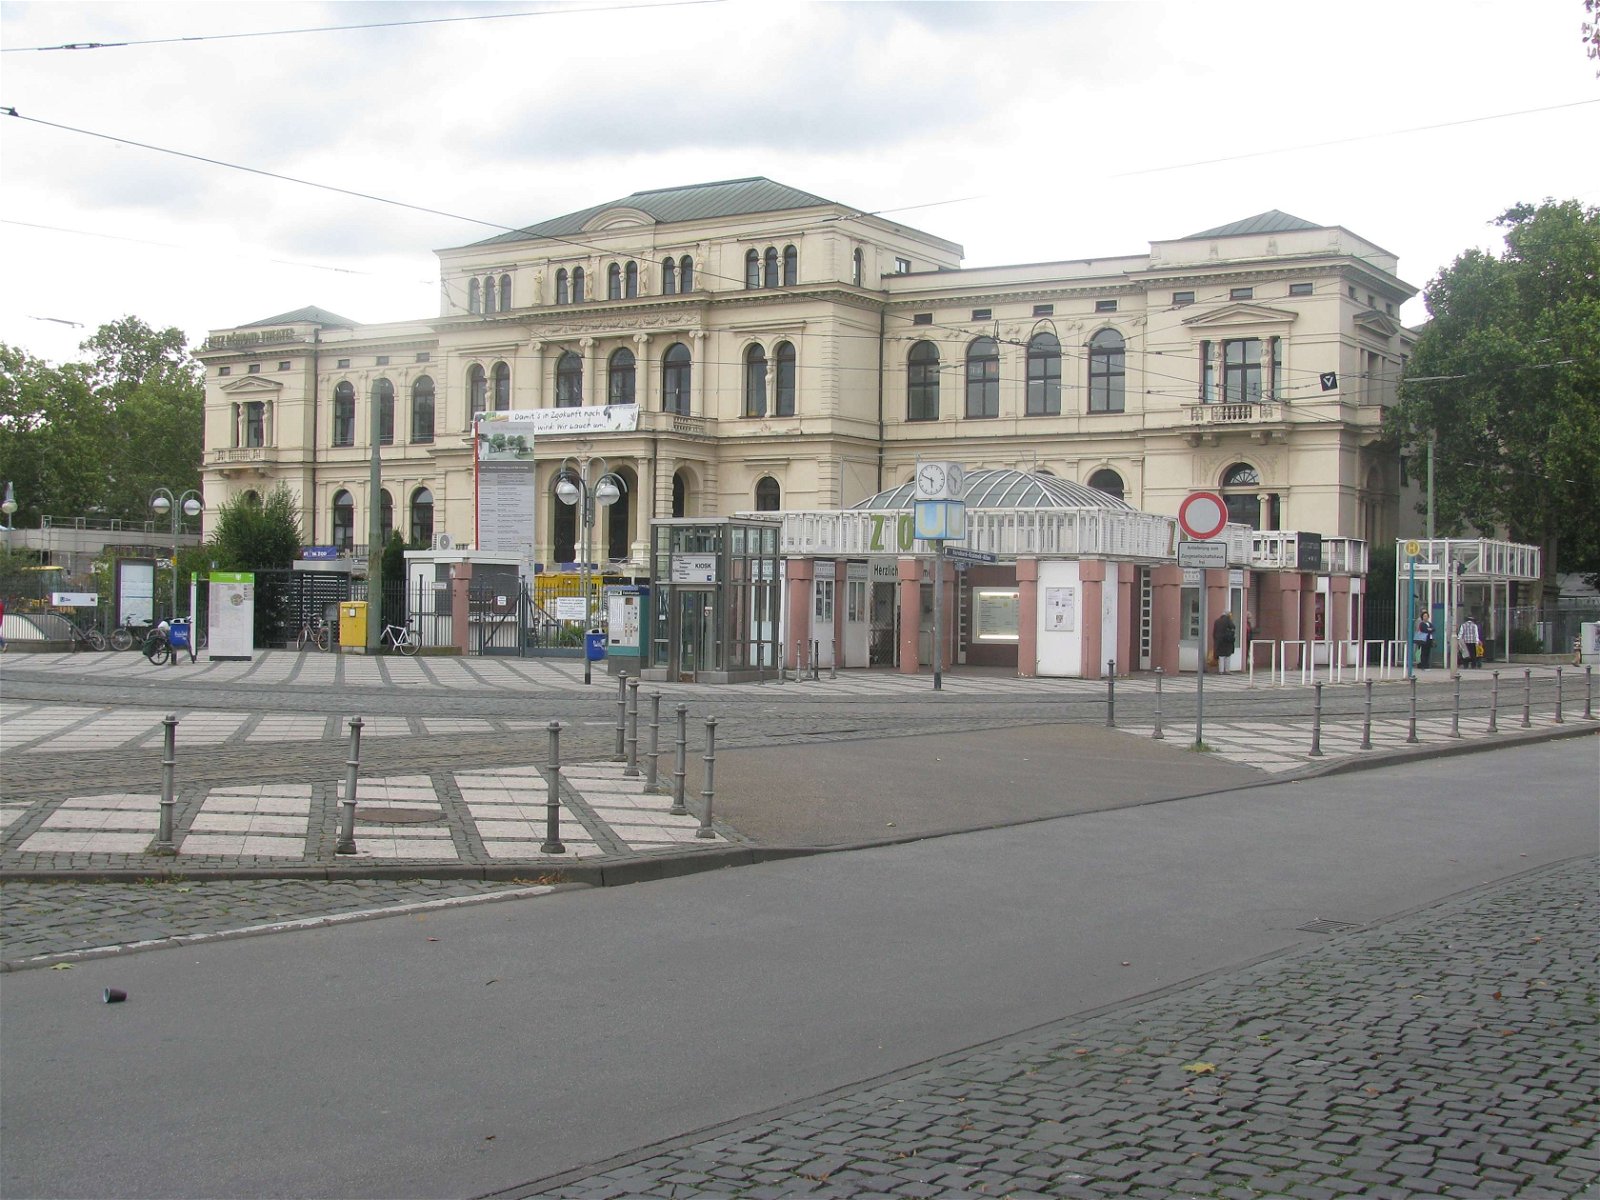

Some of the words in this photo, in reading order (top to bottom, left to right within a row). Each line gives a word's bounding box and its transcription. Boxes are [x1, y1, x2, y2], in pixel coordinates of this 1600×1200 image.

[584, 408, 600, 417] noch
[917, 503, 944, 536] U
[947, 504, 962, 536] U
[873, 564, 898, 577] Herzlich
